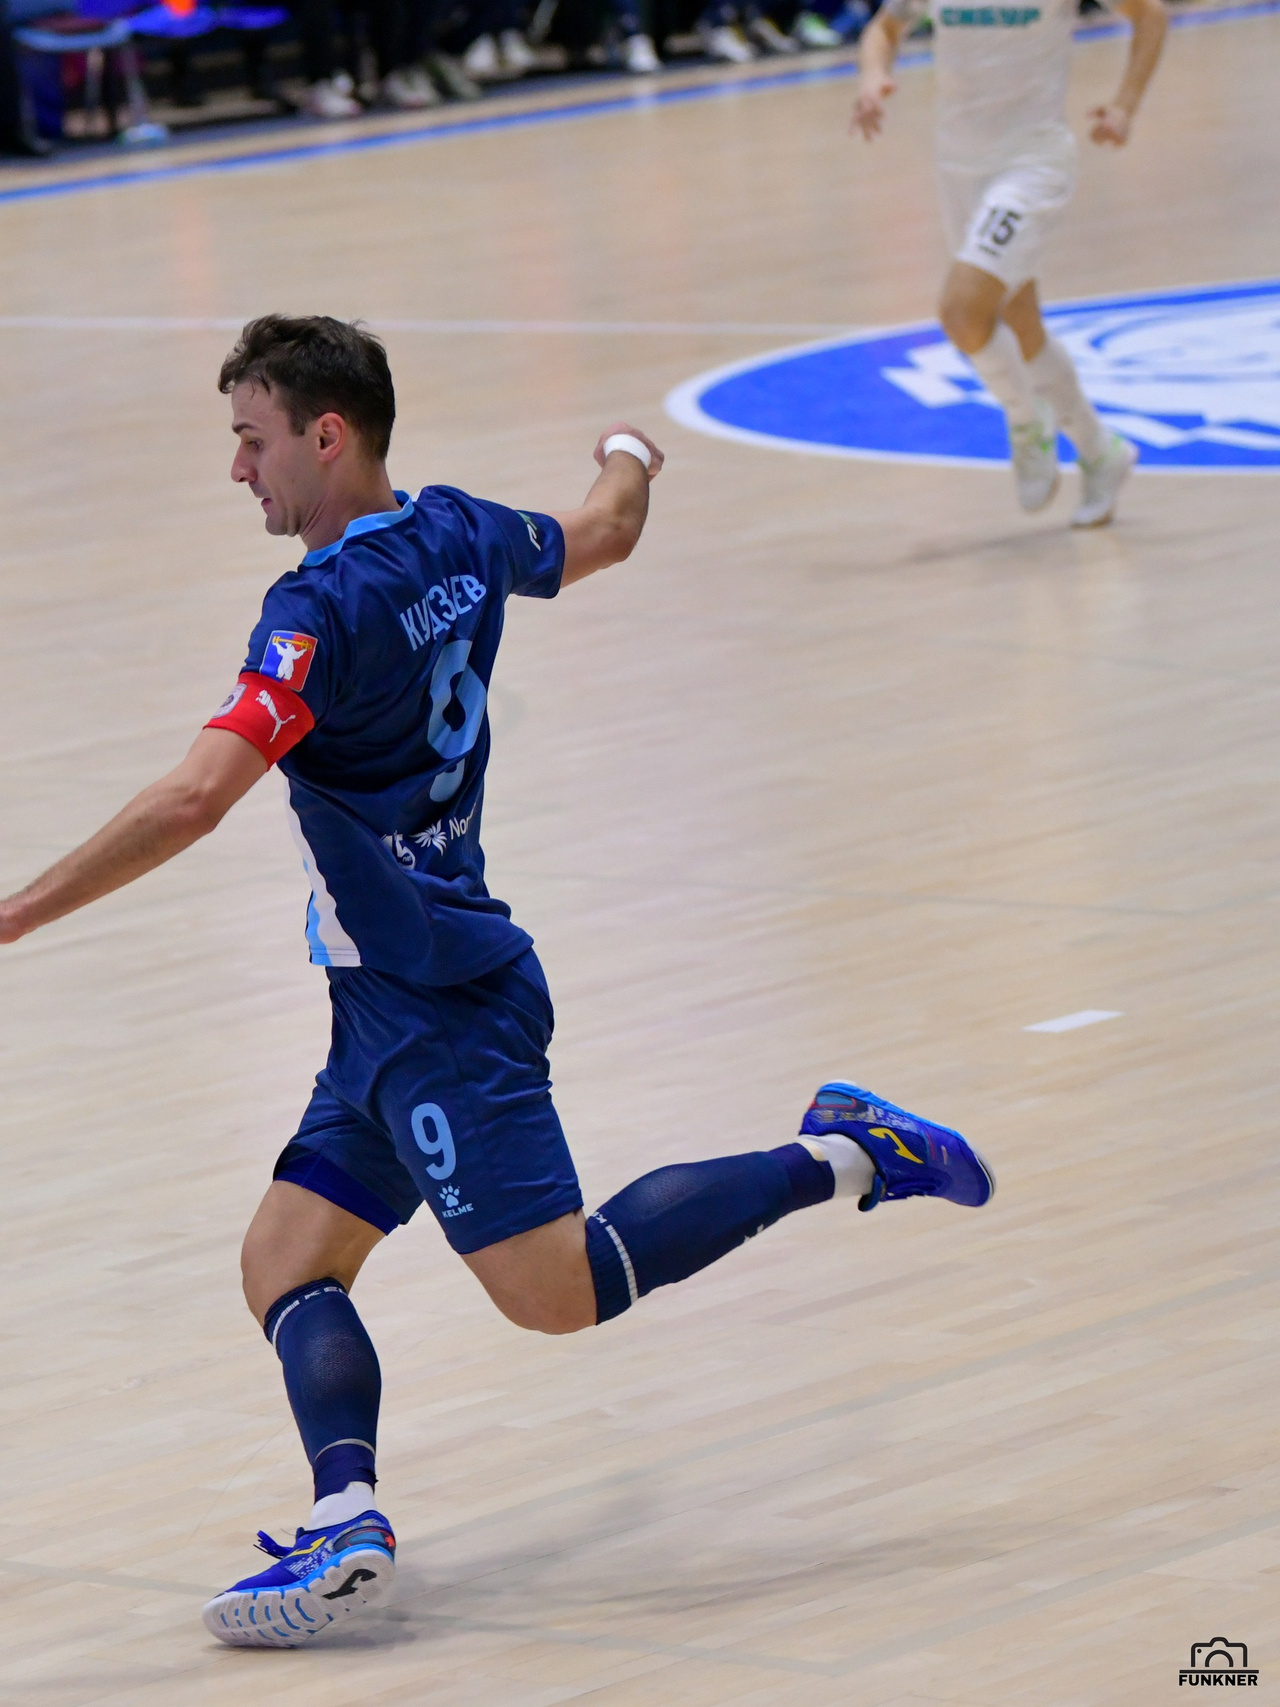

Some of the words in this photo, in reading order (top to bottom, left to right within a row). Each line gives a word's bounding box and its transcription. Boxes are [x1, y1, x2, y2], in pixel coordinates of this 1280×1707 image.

[980, 208, 1022, 246] 15
[411, 1102, 457, 1180] 9
[441, 1203, 475, 1219] KELME
